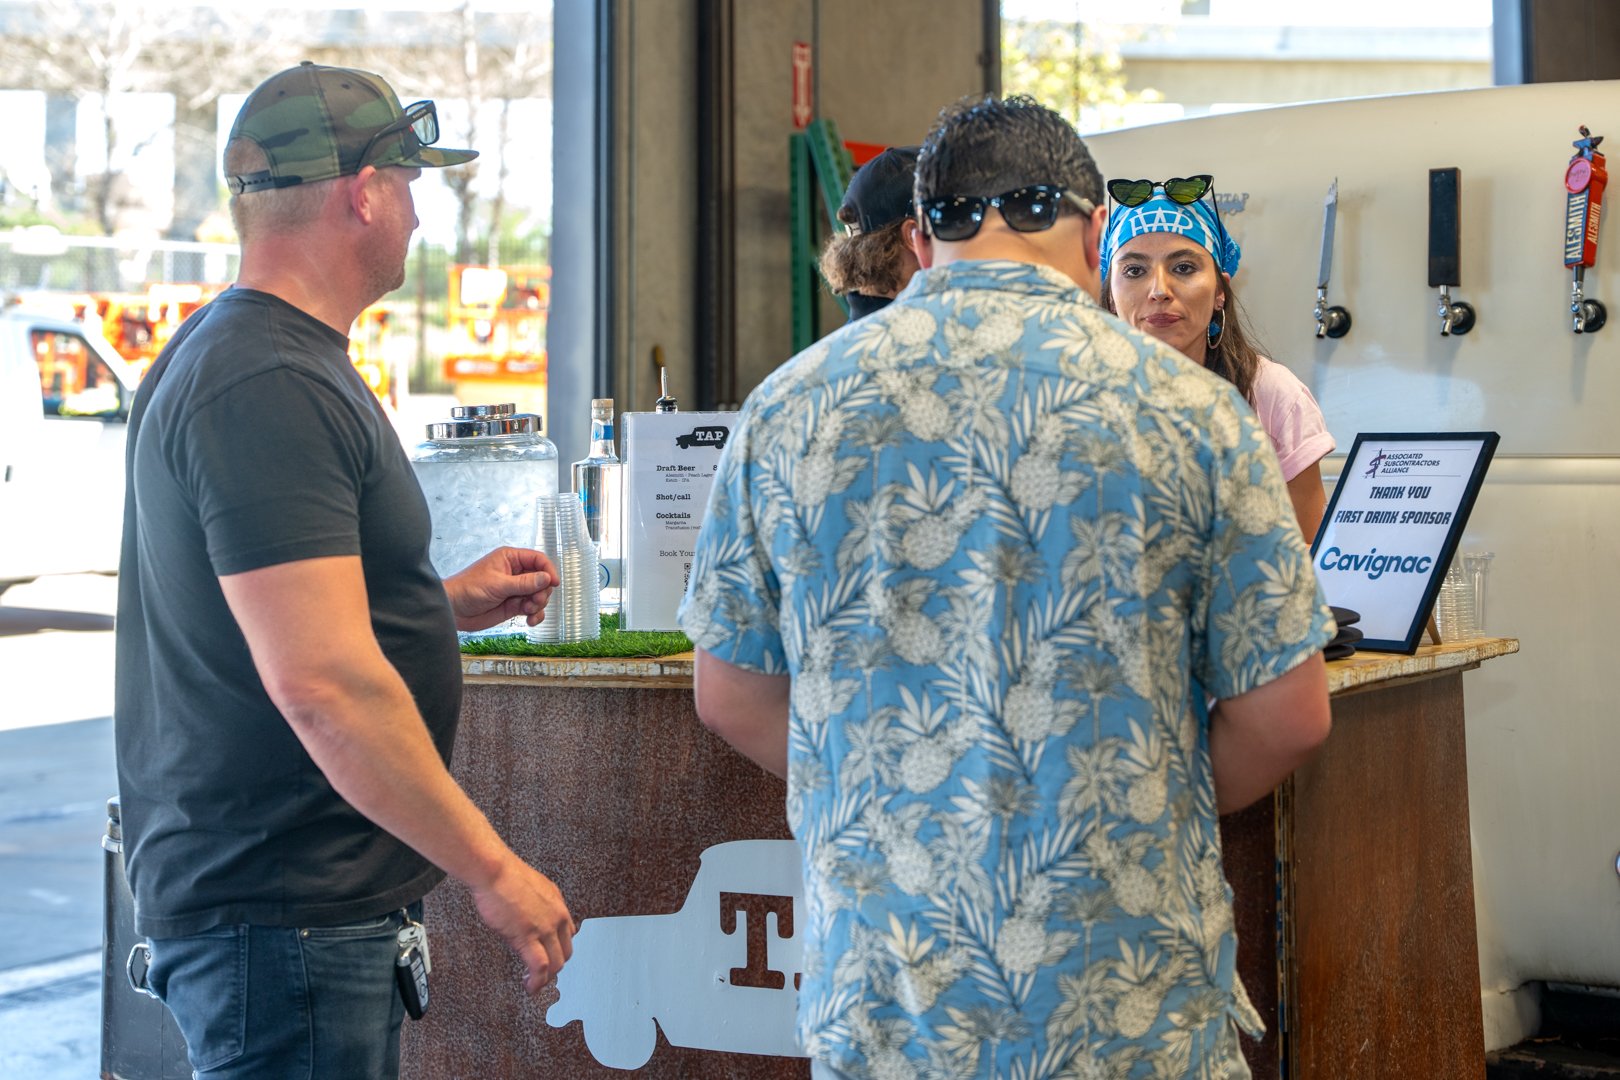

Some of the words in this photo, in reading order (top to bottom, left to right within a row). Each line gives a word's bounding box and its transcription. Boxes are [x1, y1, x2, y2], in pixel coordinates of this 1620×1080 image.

[1565, 194, 1586, 259] ALESMITH
[1587, 201, 1601, 244] ALESMITH
[695, 430, 724, 441] TAP
[656, 464, 677, 472] Draft
[678, 464, 696, 472] Beer
[656, 493, 691, 502] Shot/call
[1369, 486, 1406, 499] THANK
[1408, 486, 1432, 499] YOU
[1334, 510, 1364, 523] FIRST
[1364, 511, 1400, 524] DRINK
[1400, 511, 1452, 525] SPONSOR
[1320, 546, 1432, 580] Cavignac
